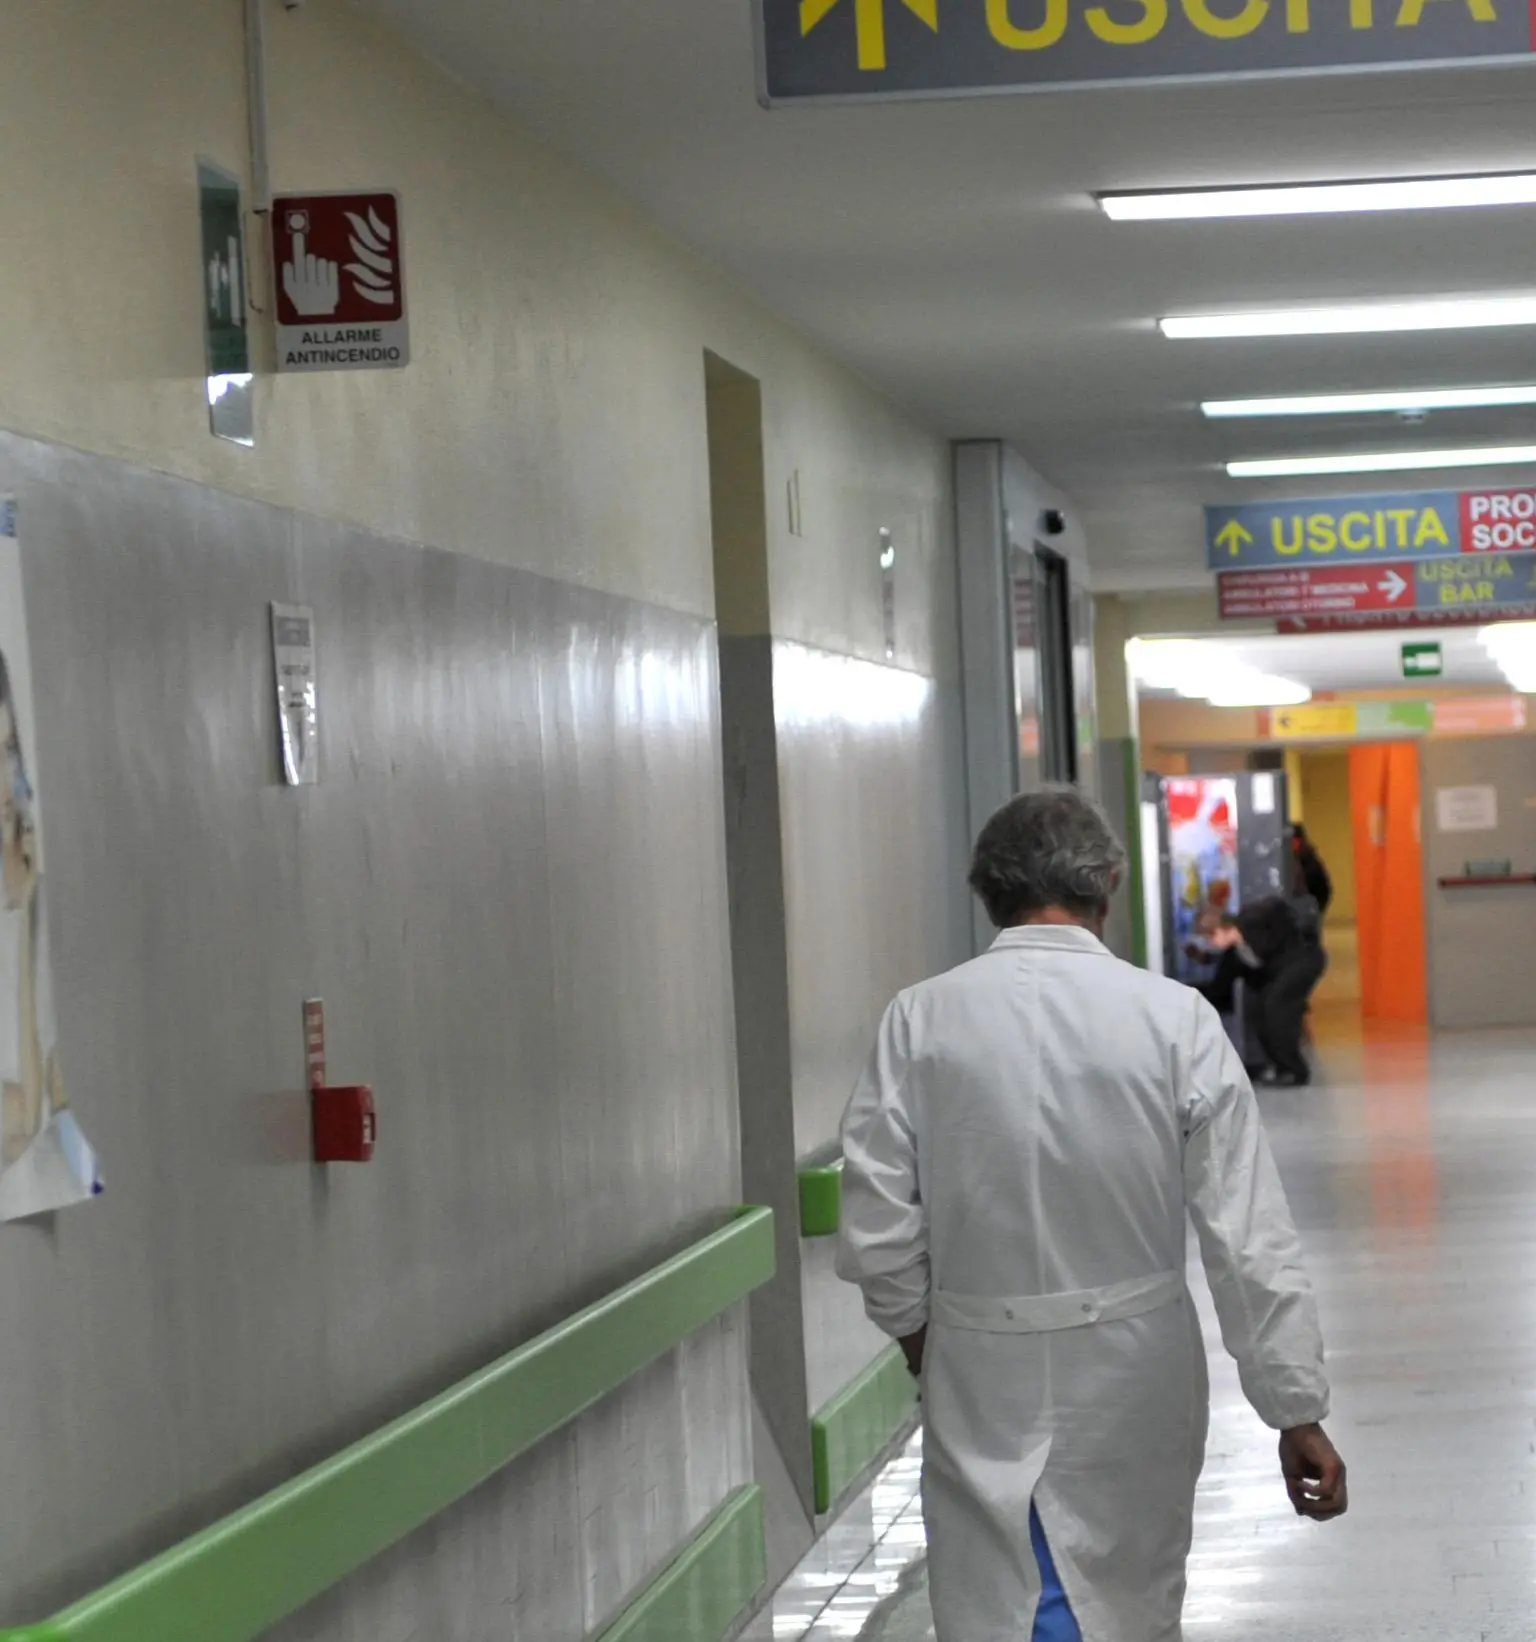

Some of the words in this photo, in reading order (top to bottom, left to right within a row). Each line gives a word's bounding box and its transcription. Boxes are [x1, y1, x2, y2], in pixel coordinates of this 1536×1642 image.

[302, 329, 382, 345] ALLARME
[285, 347, 400, 365] ANTINCENDIO
[1270, 507, 1449, 555] USCITA
[1418, 555, 1514, 581] USCITA
[1439, 581, 1495, 604] BAR
